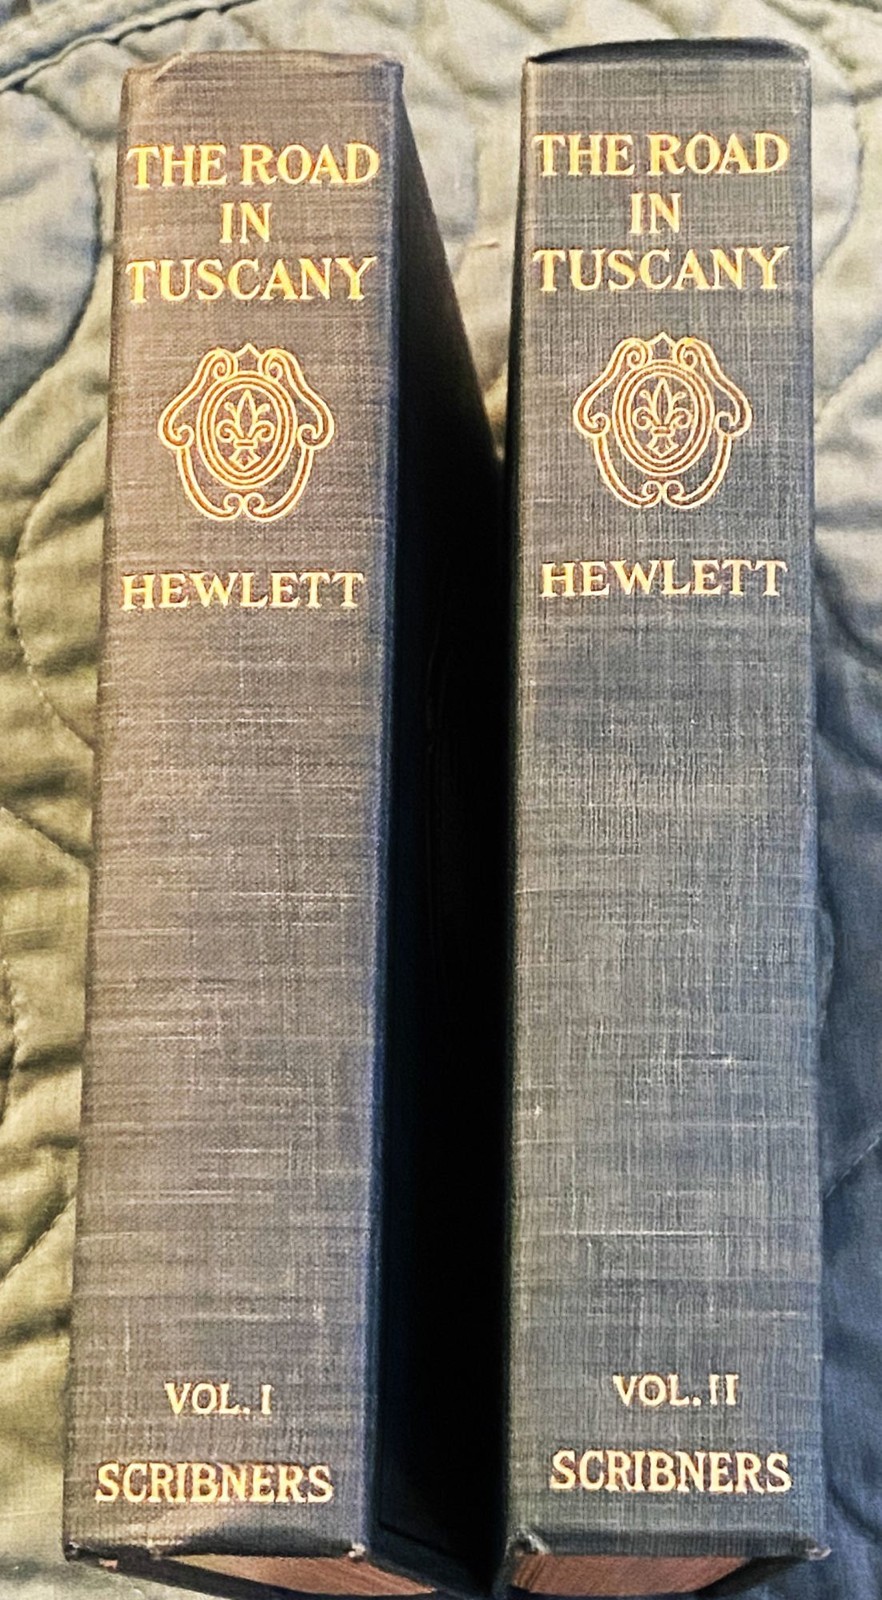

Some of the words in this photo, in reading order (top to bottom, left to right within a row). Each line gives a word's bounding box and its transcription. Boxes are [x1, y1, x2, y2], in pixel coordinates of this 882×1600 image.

[126, 143, 226, 190] THE
[242, 142, 380, 186] ROAD
[532, 132, 633, 177] THE
[648, 132, 790, 176] ROAD
[220, 202, 271, 244] IN
[630, 192, 681, 234] IN
[126, 256, 378, 305] TUSCANY
[532, 245, 790, 293] TUSCANY
[120, 571, 365, 611] HEWLETT
[541, 559, 787, 599] HEWLETT
[165, 1382, 251, 1416] VOL.
[261, 1383, 273, 1416] I
[613, 1374, 702, 1408] VOL.
[709, 1374, 738, 1407] II
[95, 1463, 334, 1504] SCRIBNERS
[550, 1450, 792, 1494] SCRIBNERS
